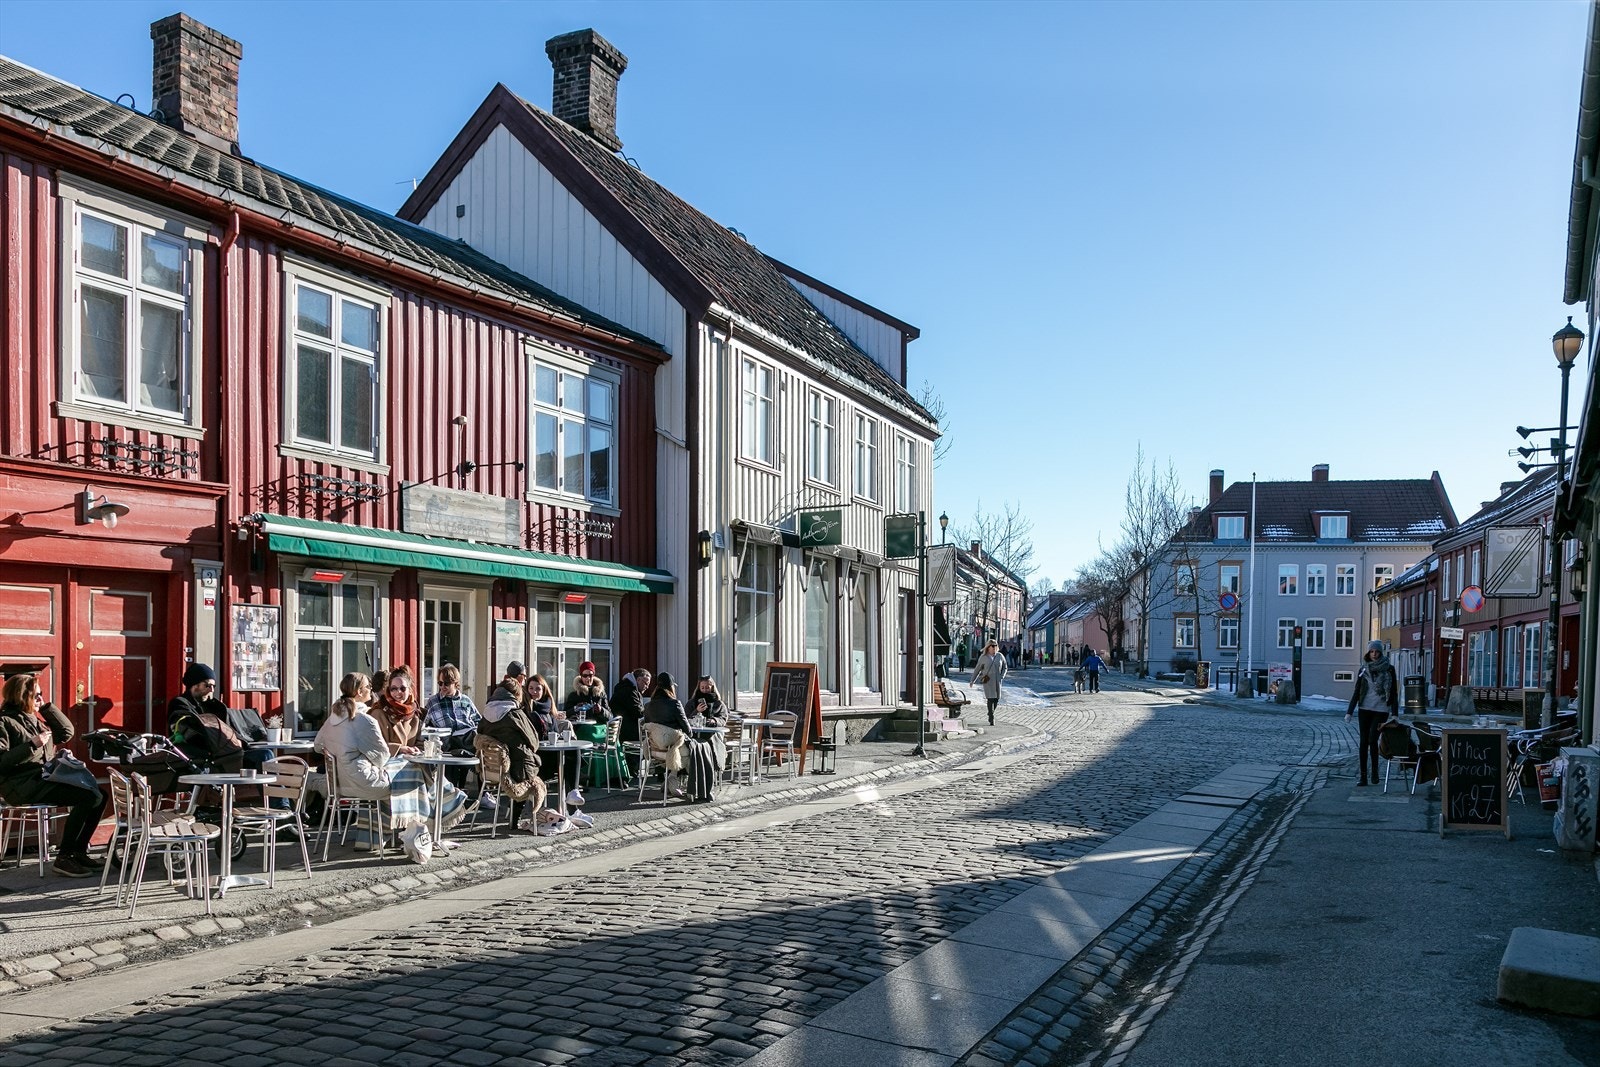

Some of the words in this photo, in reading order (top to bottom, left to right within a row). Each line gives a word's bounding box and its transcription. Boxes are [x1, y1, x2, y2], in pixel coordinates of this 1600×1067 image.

[1496, 532, 1526, 545] Son
[206, 571, 214, 585] 3
[1450, 739, 1462, 758] Vi
[1465, 741, 1492, 761] har
